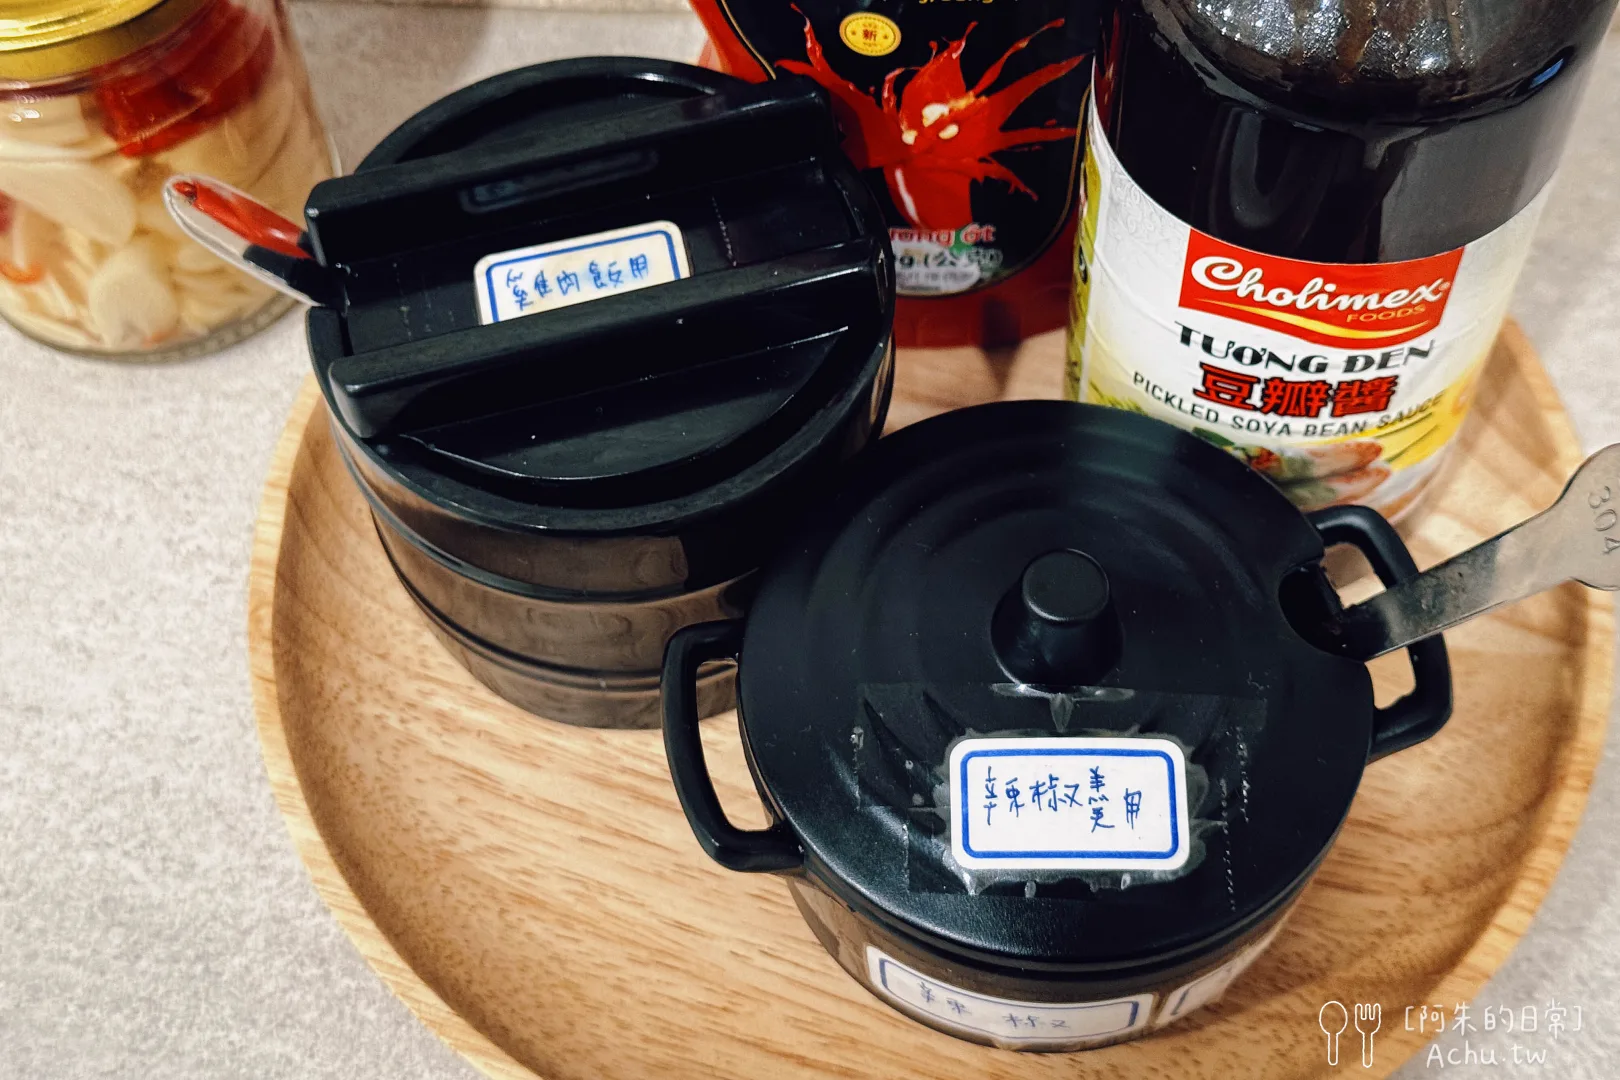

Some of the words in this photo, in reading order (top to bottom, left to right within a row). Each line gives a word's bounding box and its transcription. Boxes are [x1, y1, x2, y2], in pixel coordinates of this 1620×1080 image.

[1191, 255, 1444, 312] Cholimex
[1346, 304, 1426, 323] FOODS
[1173, 321, 1329, 374] TƯƠNG
[1132, 371, 1220, 424] PICKLED
[1230, 416, 1291, 437] SOYA
[1304, 421, 1369, 437] BEAN
[1378, 395, 1444, 429] SAUCE
[1192, 361, 1399, 419] 豆瓣醬
